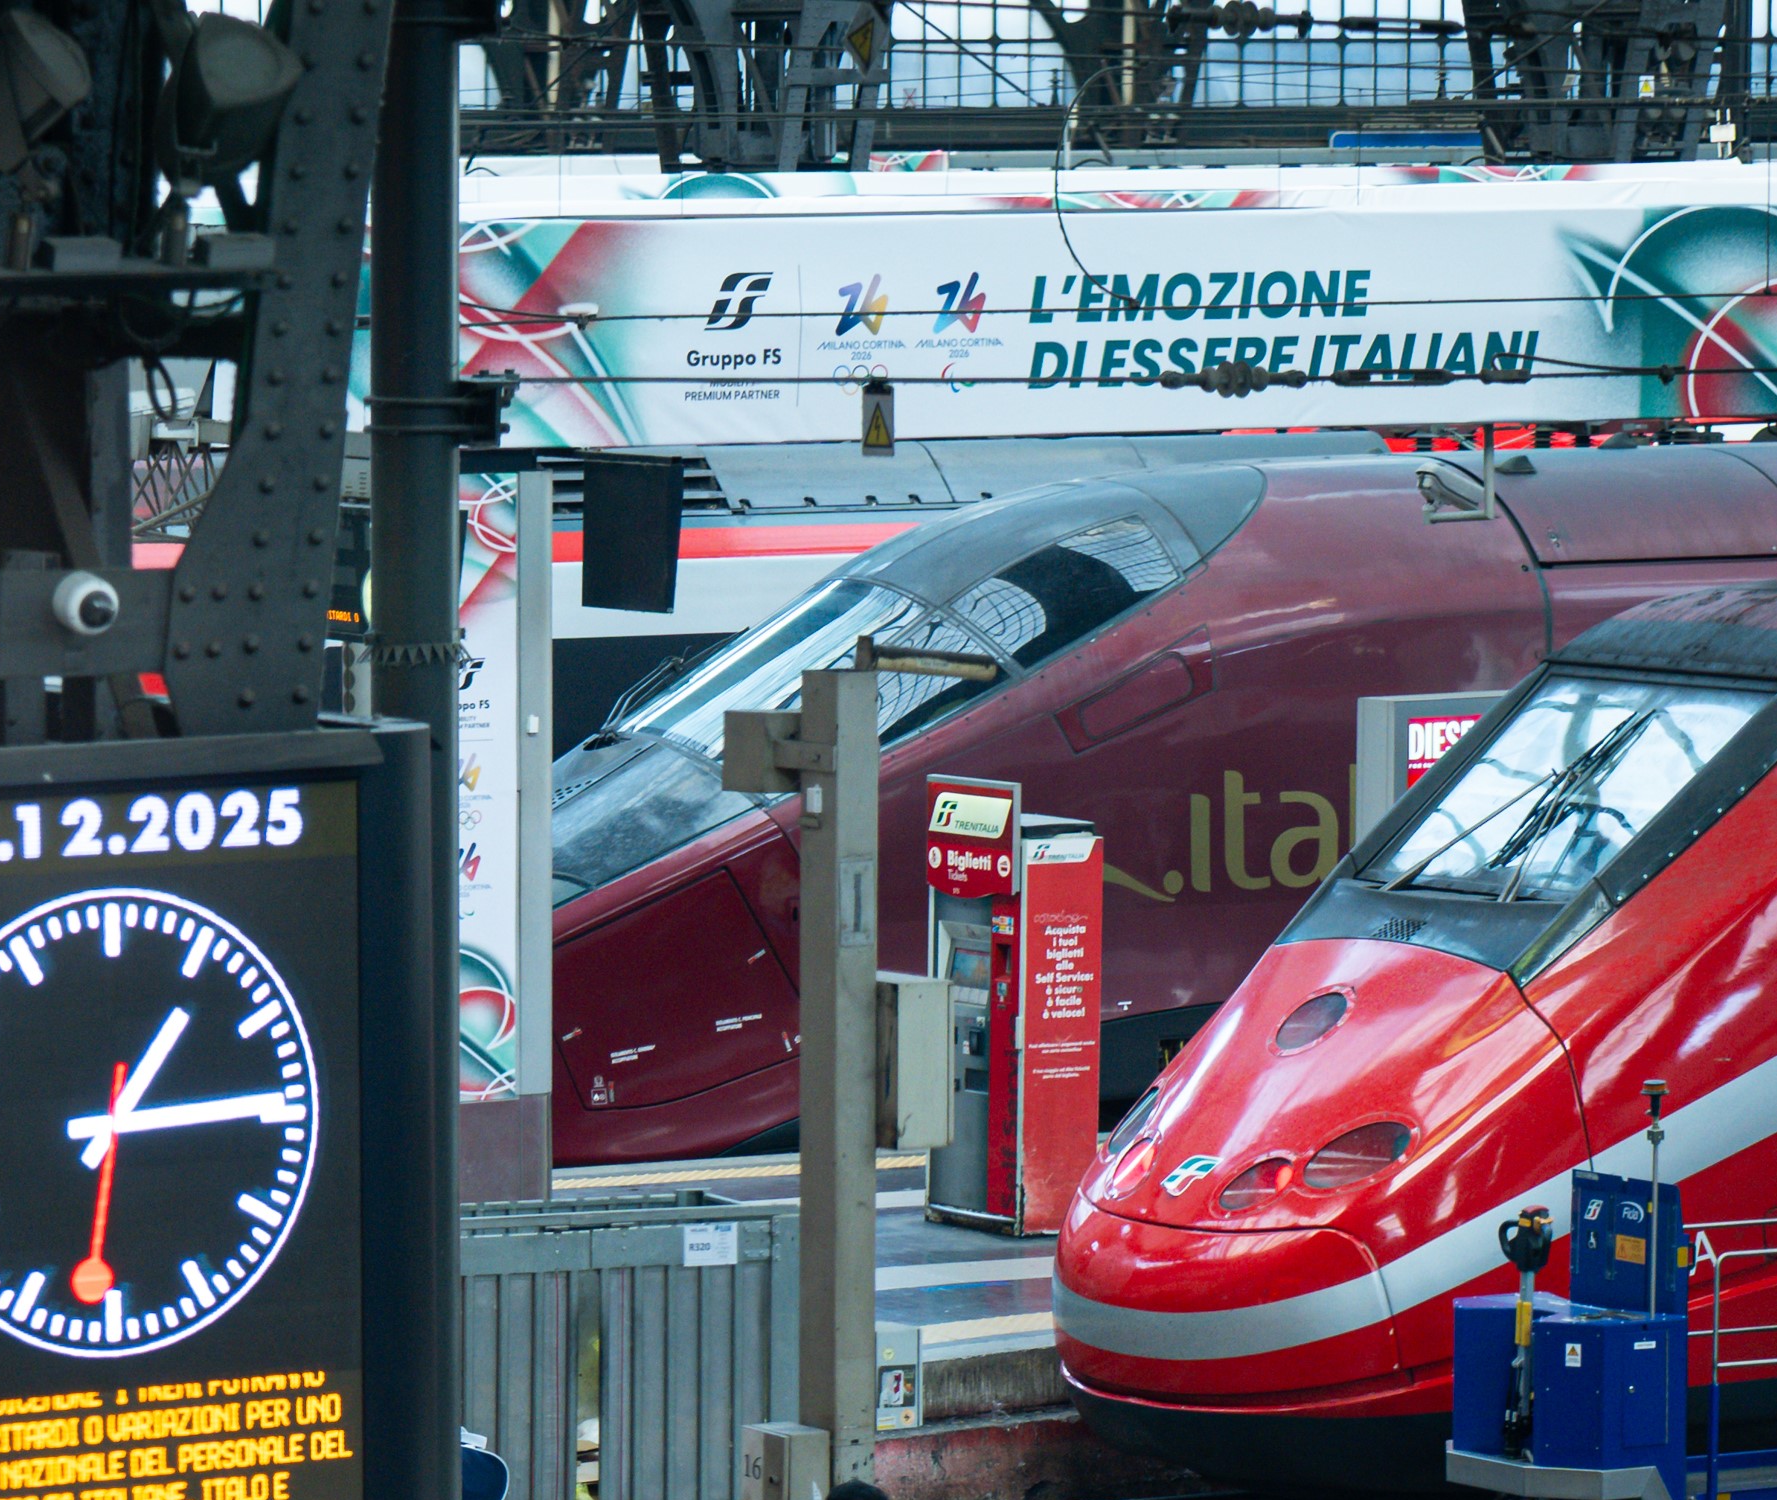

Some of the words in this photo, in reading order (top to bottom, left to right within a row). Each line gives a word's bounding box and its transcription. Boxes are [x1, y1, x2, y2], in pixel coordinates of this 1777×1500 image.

[1029, 270, 1371, 324] L'EMOZIONE
[817, 340, 860, 350] MILANO
[862, 340, 907, 350] CORTINA
[915, 338, 959, 348] MILANO
[961, 337, 1004, 347] CORTINA
[687, 350, 756, 371] Gruppo
[762, 348, 782, 365] FS
[851, 351, 872, 361] 2026
[949, 349, 970, 359] 2026
[1028, 340, 1088, 389] DI
[685, 390, 732, 401] PREMIUM
[734, 389, 780, 400] PARTNER
[479, 700, 490, 709] FS
[955, 820, 999, 834] TRENITALIA
[947, 850, 991, 871] Biglietti
[948, 870, 968, 882] Tickets
[1045, 925, 1086, 937] Acquista
[1053, 937, 1057, 947] i
[1058, 936, 1078, 947] tuoi
[1046, 948, 1084, 961] biglietti
[1035, 973, 1055, 984] Self
[1056, 971, 1094, 983] Service:
[1045, 985, 1052, 995] è
[1054, 985, 1083, 995] sicuro
[1046, 996, 1053, 1007] è
[1055, 996, 1082, 1006] facile
[1042, 1009, 1049, 1019] è
[1051, 1007, 1085, 1019] veloce!
[1622, 1206, 1639, 1221] Fida
[689, 1243, 711, 1251] R320
[83, 1415, 104, 1445] O
[106, 1402, 240, 1442] VARIAZIONI
[245, 1398, 291, 1430] PER
[295, 1393, 342, 1426] UNO
[130, 1447, 175, 1478] DEL
[178, 1432, 305, 1473] PERSONALE
[310, 1429, 353, 1461] DEL
[744, 1454, 761, 1480] 16
[273, 1471, 290, 1500] E
